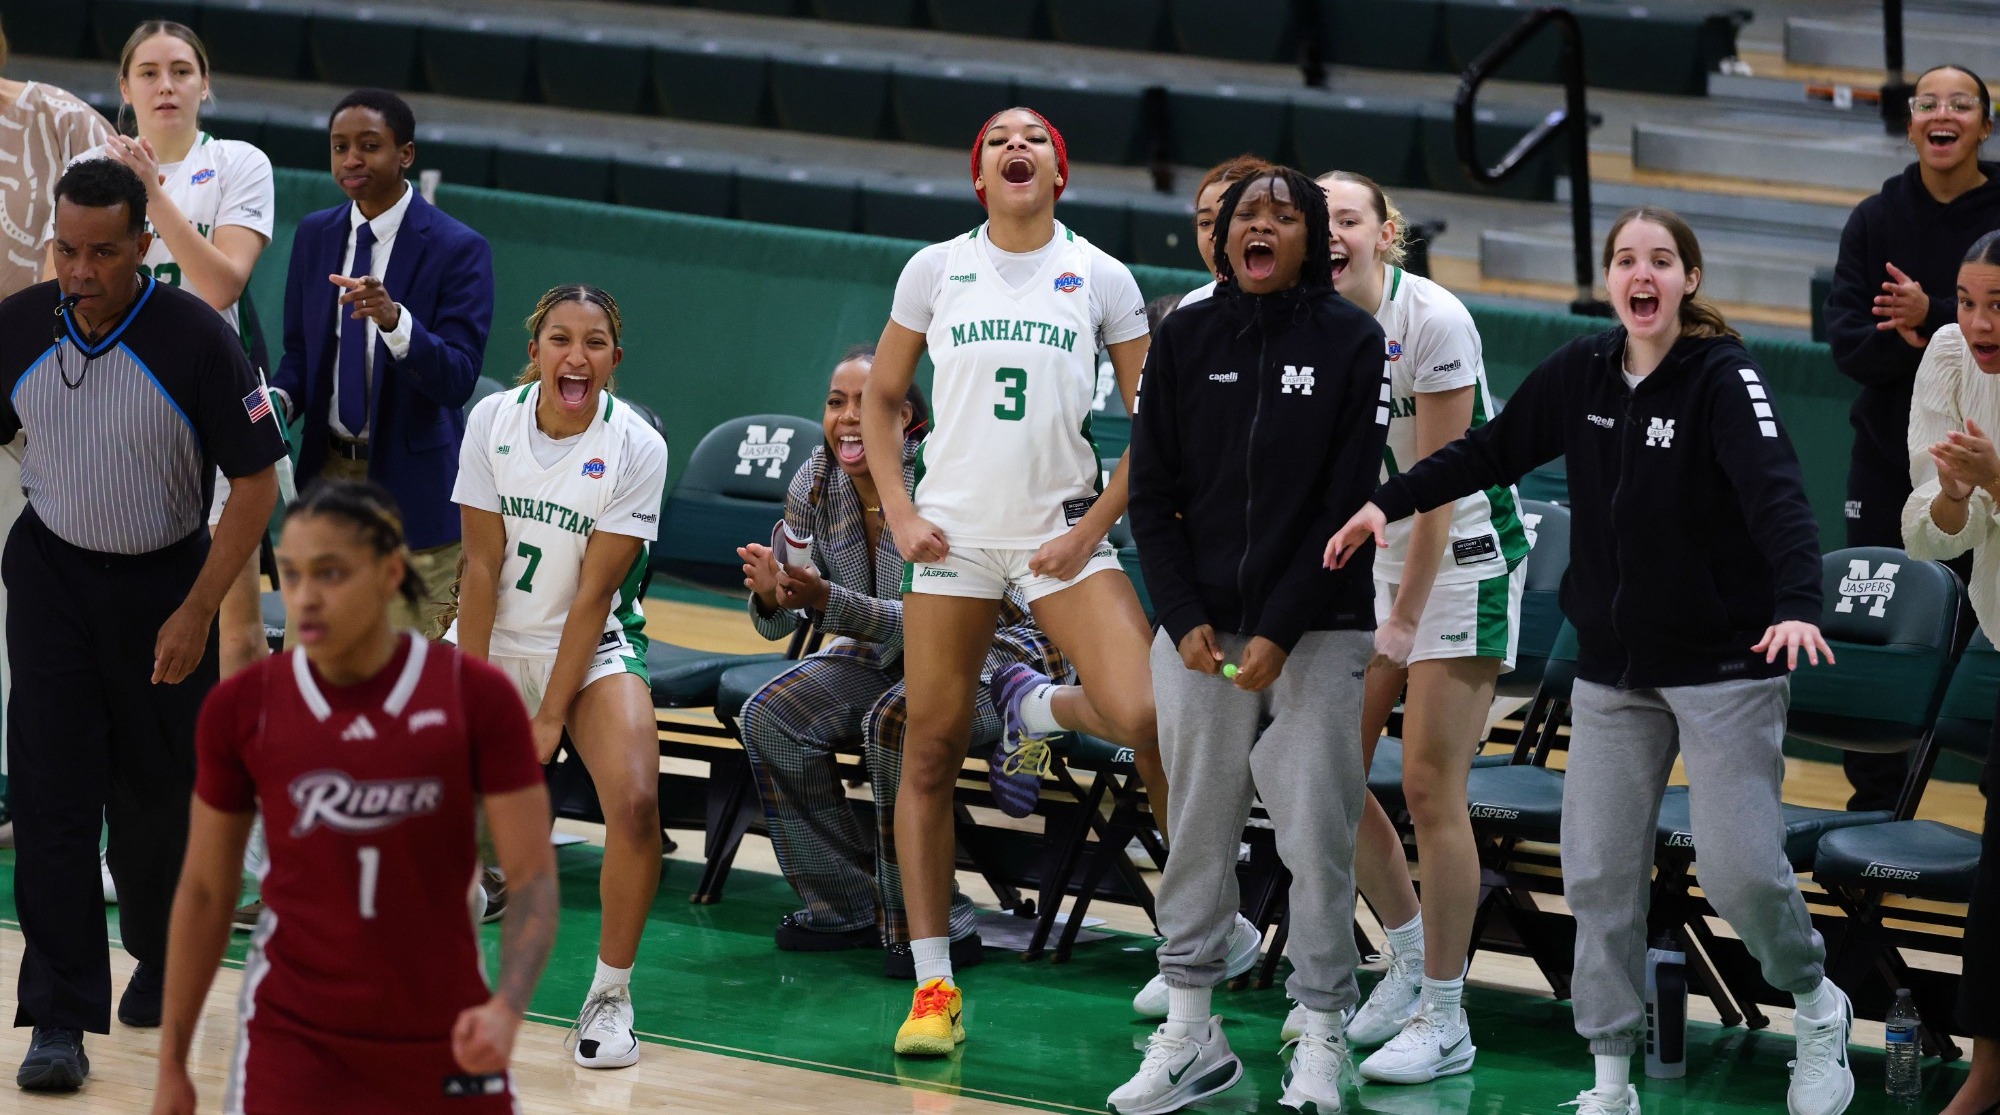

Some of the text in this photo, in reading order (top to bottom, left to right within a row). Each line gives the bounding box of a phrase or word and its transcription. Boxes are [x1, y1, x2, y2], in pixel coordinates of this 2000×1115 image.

[950, 273, 977, 282] capelli
[1054, 276, 1084, 291] MAAC
[951, 319, 1078, 352] MANHATTAN
[1433, 360, 1461, 371] capelli
[1209, 372, 1238, 382] capelli
[994, 367, 1028, 421] 3
[1587, 414, 1615, 428] capelli
[743, 444, 786, 457] JASPERS
[499, 494, 595, 537] ANHATTAN
[632, 512, 657, 522] capelli
[515, 541, 542, 593] 7
[1843, 582, 1891, 593] JASPERS
[1440, 632, 1468, 642] capelli
[289, 770, 442, 836] RIDER
[1861, 861, 1920, 880] JASPERS
[358, 847, 380, 919] 1
